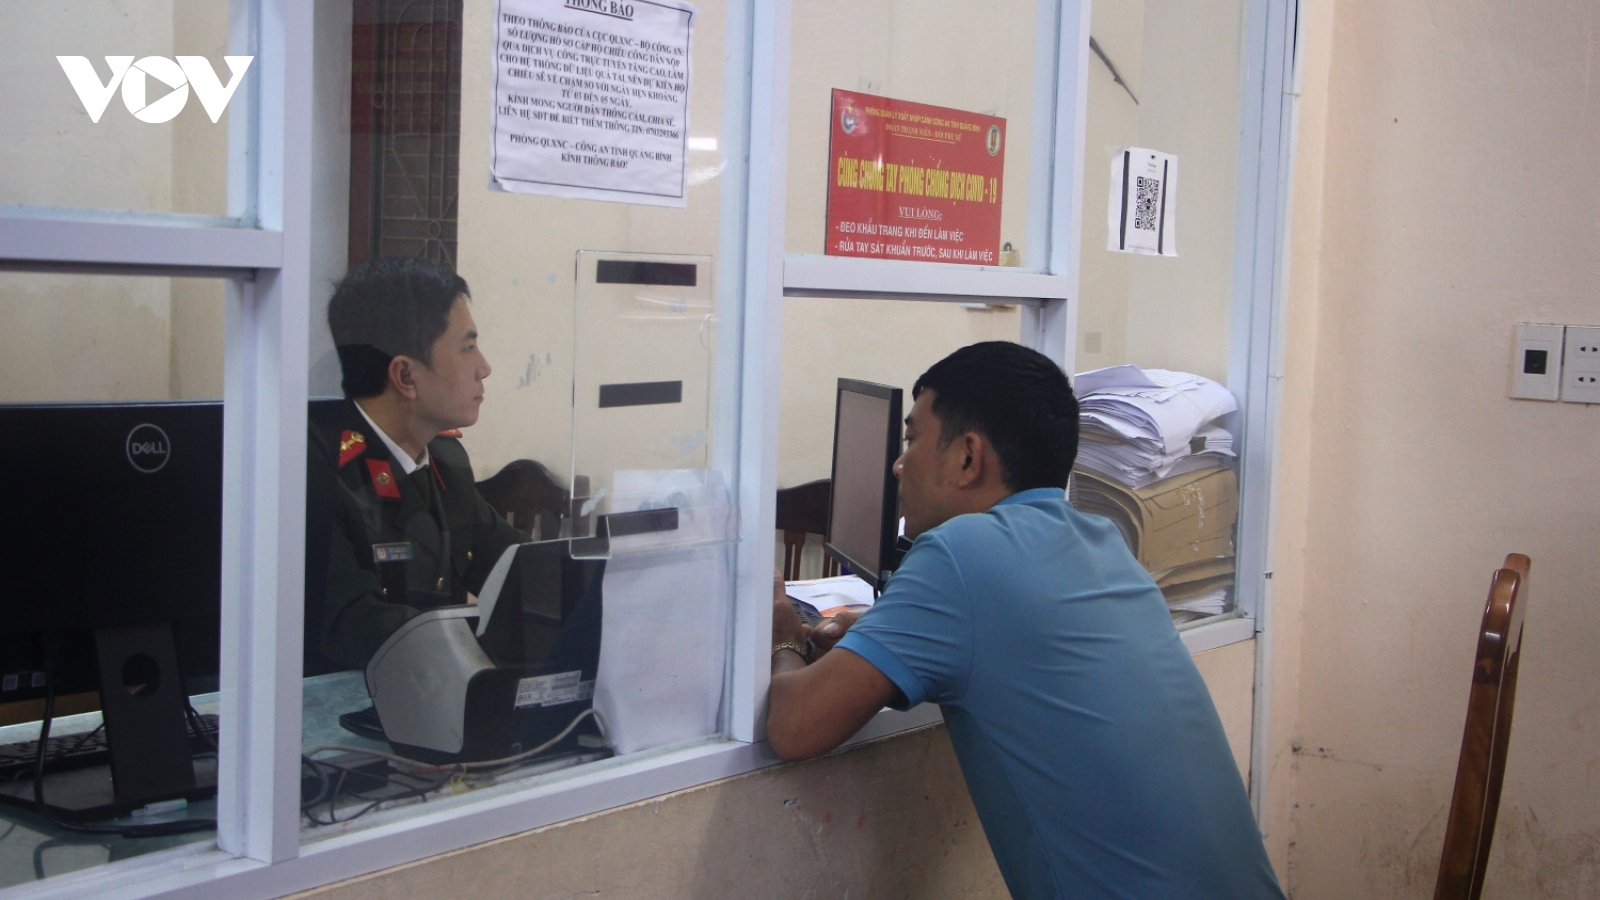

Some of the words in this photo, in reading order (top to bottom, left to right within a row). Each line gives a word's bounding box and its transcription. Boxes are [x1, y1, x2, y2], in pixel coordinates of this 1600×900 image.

[503, 14, 525, 26] THEO
[528, 18, 556, 31] THÔNG
[558, 23, 573, 34] BÁO
[652, 42, 671, 54] CÔNG
[503, 41, 519, 51] QUA
[522, 44, 542, 55] DỊCH
[544, 47, 555, 59] VỤ
[557, 49, 578, 61] CÔNG
[628, 49, 648, 62] CÔNG
[500, 53, 518, 64] CHO
[520, 56, 530, 68] HỆ
[577, 66, 593, 78] LIỆU
[584, 81, 594, 89] SO
[575, 92, 581, 100] 03
[499, 105, 517, 116] LIÊN
[520, 108, 530, 120] HỆ
[581, 117, 602, 128] THÊM
[605, 120, 629, 132] THÔNG
[508, 93, 528, 105] KÍNH
[531, 98, 555, 109] MONG
[602, 108, 626, 120] THÔNG
[648, 115, 664, 125] CHIA
[511, 133, 538, 145] PHÒNG
[576, 141, 597, 153] CÔNG
[598, 146, 608, 154] AN
[562, 152, 580, 163] KÍNH
[583, 155, 608, 167] THÔNG
[838, 151, 858, 188] CÙNG
[860, 159, 884, 191] CHUNG
[886, 163, 898, 192] TAY
[899, 159, 924, 195] PHÒNG
[926, 159, 949, 198] CHỐNG
[950, 172, 965, 205] DỊCH
[966, 173, 984, 202] COVID
[990, 177, 997, 204] 19
[899, 207, 914, 217] VUI
[917, 206, 942, 220] LÒNG:
[840, 221, 855, 233] ĐEO
[857, 218, 877, 235] KHẨU
[879, 226, 903, 236] TRANG
[905, 227, 917, 237] KHI
[918, 224, 932, 238] ĐẾN
[934, 228, 947, 240] LÀM
[950, 229, 964, 243] VIỆC
[839, 237, 854, 252] RỬA
[856, 242, 868, 252] TAY
[871, 241, 884, 254] SÁT
[886, 240, 910, 256] KHUẨN
[912, 245, 937, 259] TRƯỚC,
[939, 248, 950, 258] SAU
[953, 249, 963, 259] KHI
[965, 248, 977, 260] LÀM
[979, 249, 992, 264] VIỆC
[132, 442, 165, 455] DELL
